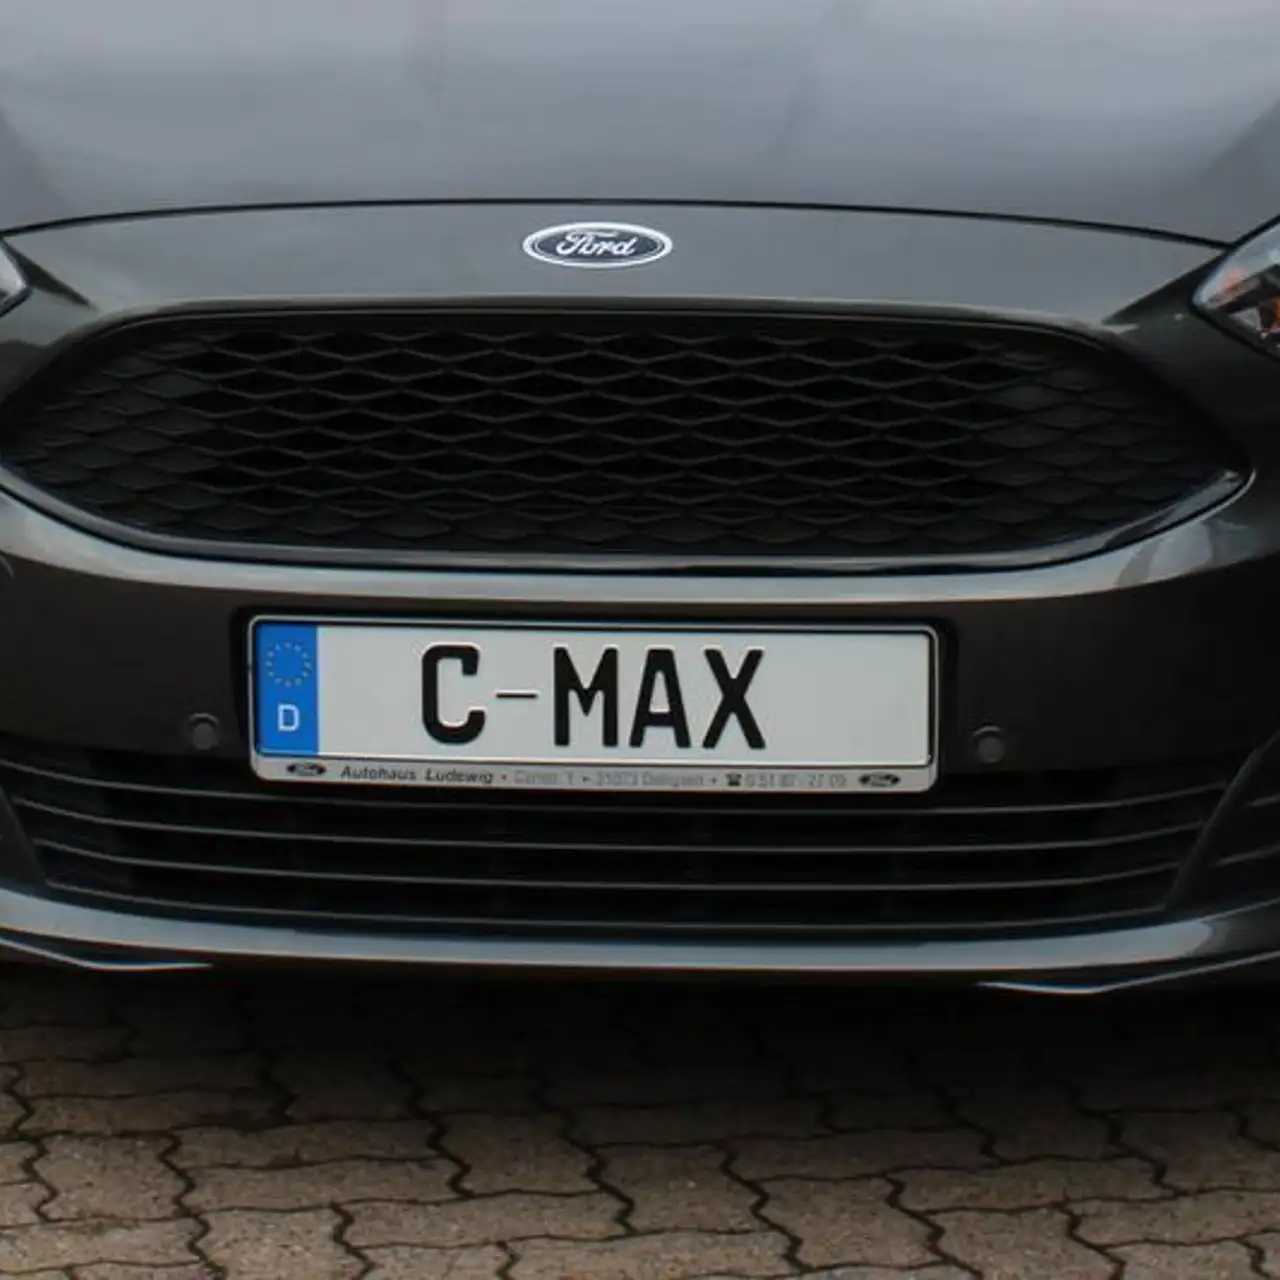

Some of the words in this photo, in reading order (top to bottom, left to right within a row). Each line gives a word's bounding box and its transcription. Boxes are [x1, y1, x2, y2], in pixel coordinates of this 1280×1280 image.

[556, 231, 638, 256] Ford
[421, 644, 766, 749] C-MAX
[277, 704, 300, 732] D
[340, 764, 417, 782] Autohaus
[425, 768, 494, 785] Ludewig
